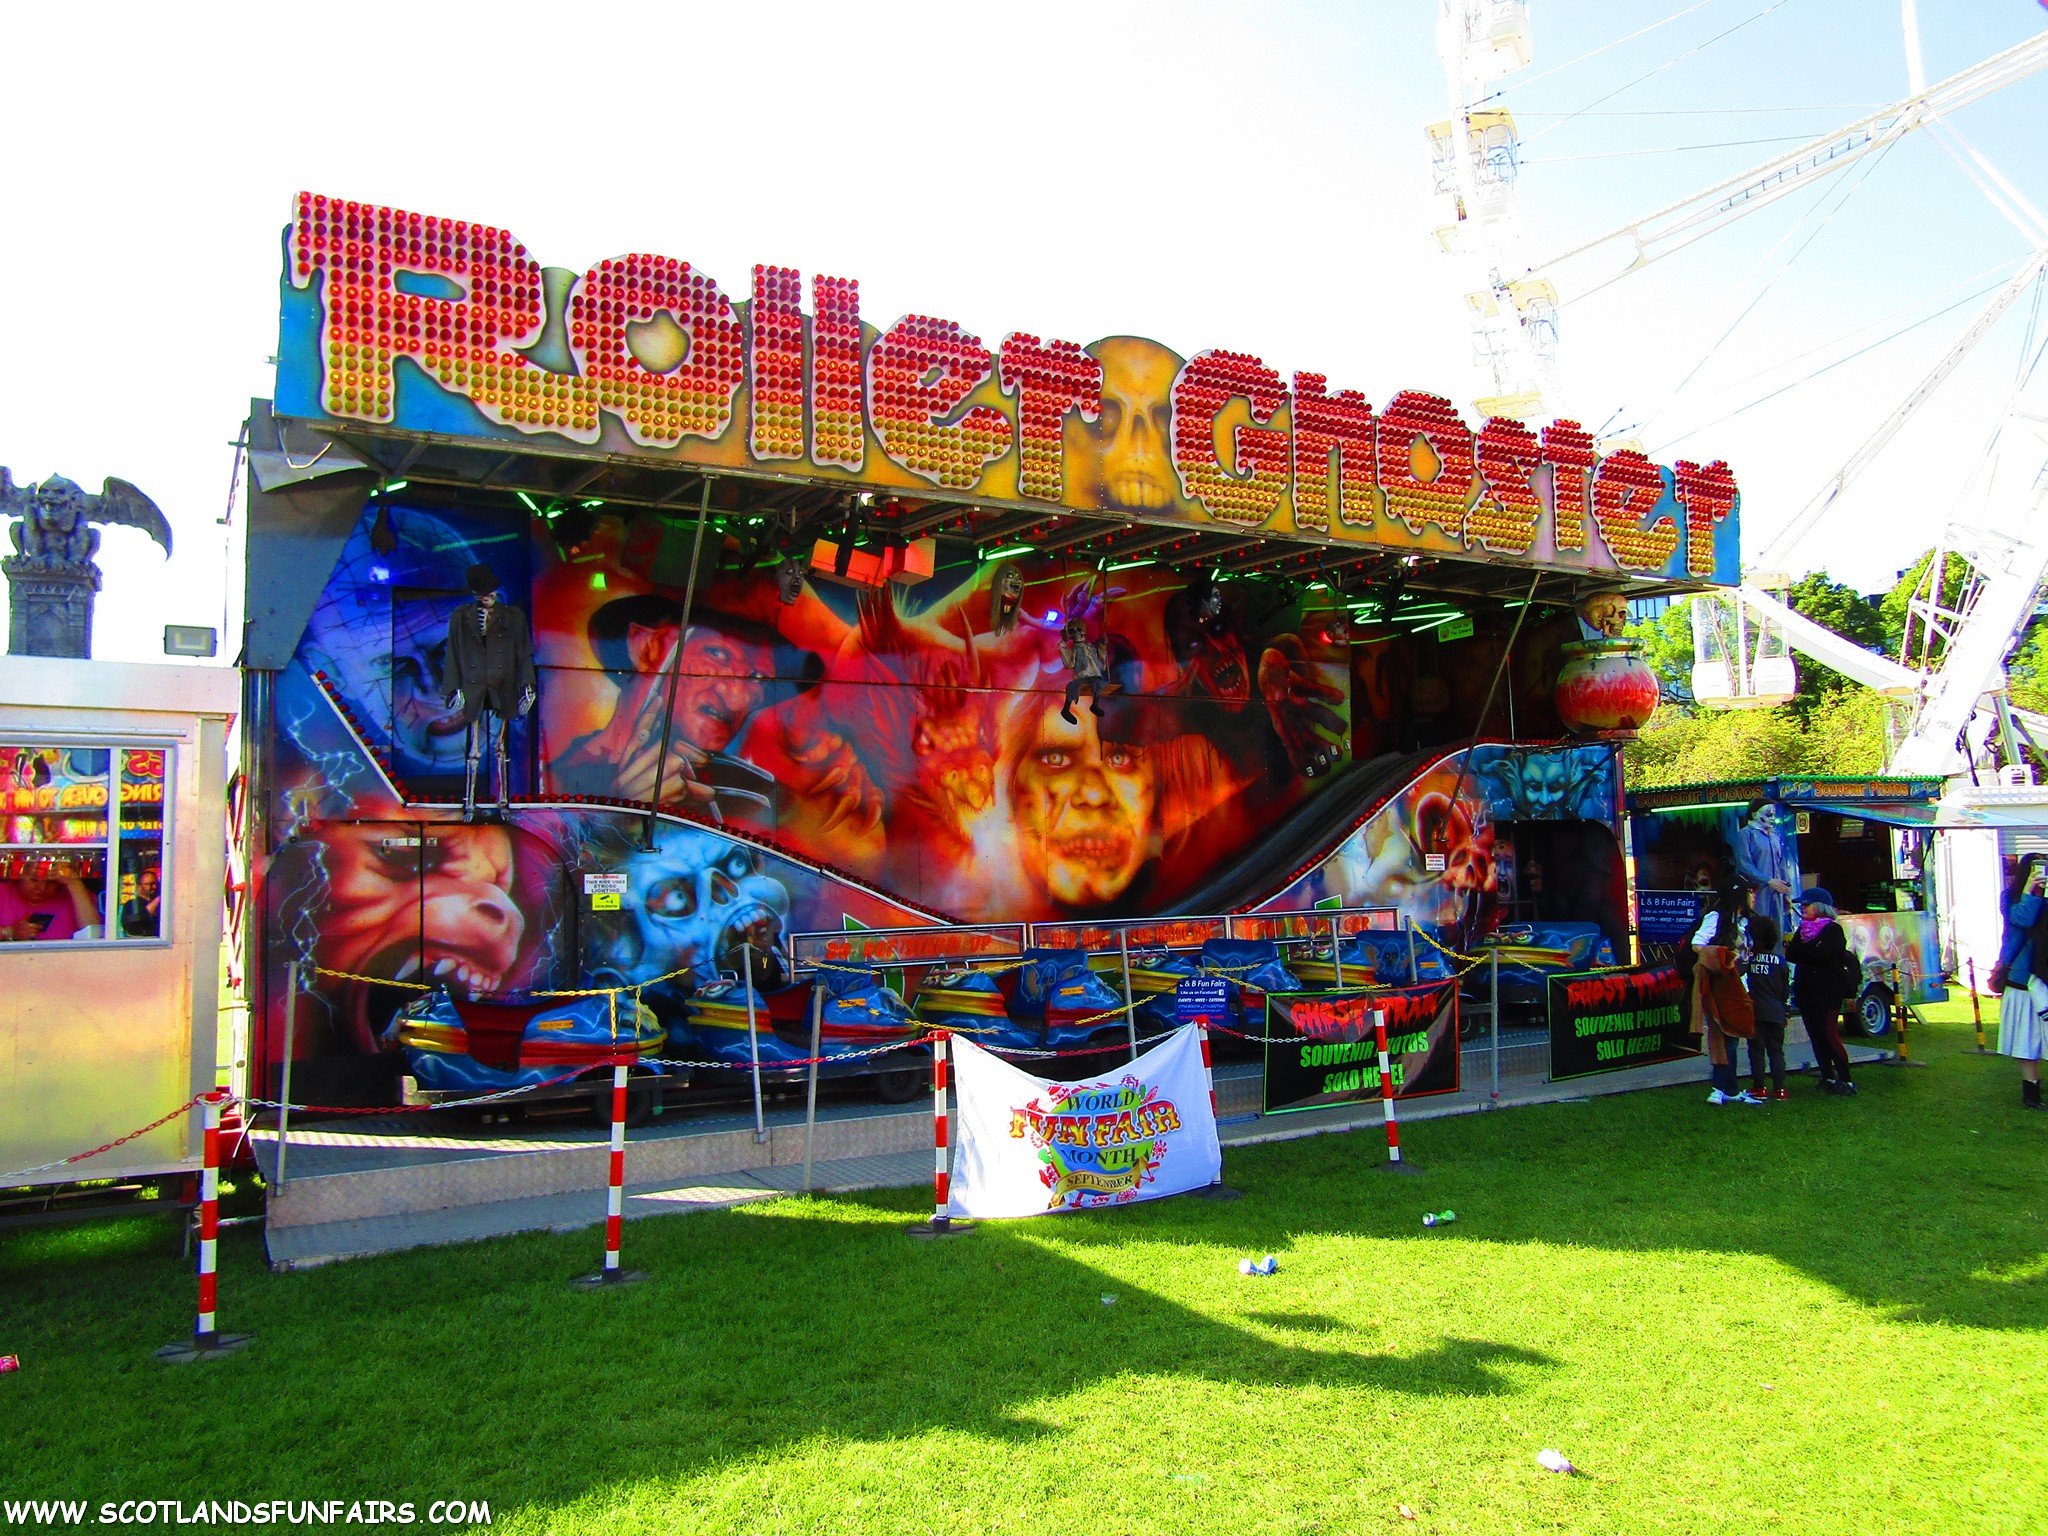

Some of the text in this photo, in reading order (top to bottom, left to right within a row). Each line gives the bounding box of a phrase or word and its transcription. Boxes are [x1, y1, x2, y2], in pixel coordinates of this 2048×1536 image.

[1813, 781, 1867, 797] Souvenir
[1869, 781, 1909, 797] Photos
[1661, 898, 1675, 906] Fun
[1677, 898, 1696, 907] Fairs
[1345, 916, 1370, 932] CAR
[826, 935, 992, 960] DO NOT STAND UP
[1750, 964, 1769, 975] NETS
[1567, 976, 1627, 1009] GHOST
[1290, 999, 1368, 1036] GHOST
[1574, 1004, 1681, 1038] SOUVENIR PHOTOS
[1300, 1031, 1429, 1067] SOUVENIR HOTOS
[1596, 1034, 1662, 1061] SOLD HERE!
[1323, 1064, 1405, 1094] SOLD HEE!
[1067, 1090, 1135, 1111] WORLD
[1062, 1148, 1136, 1166] MONTH
